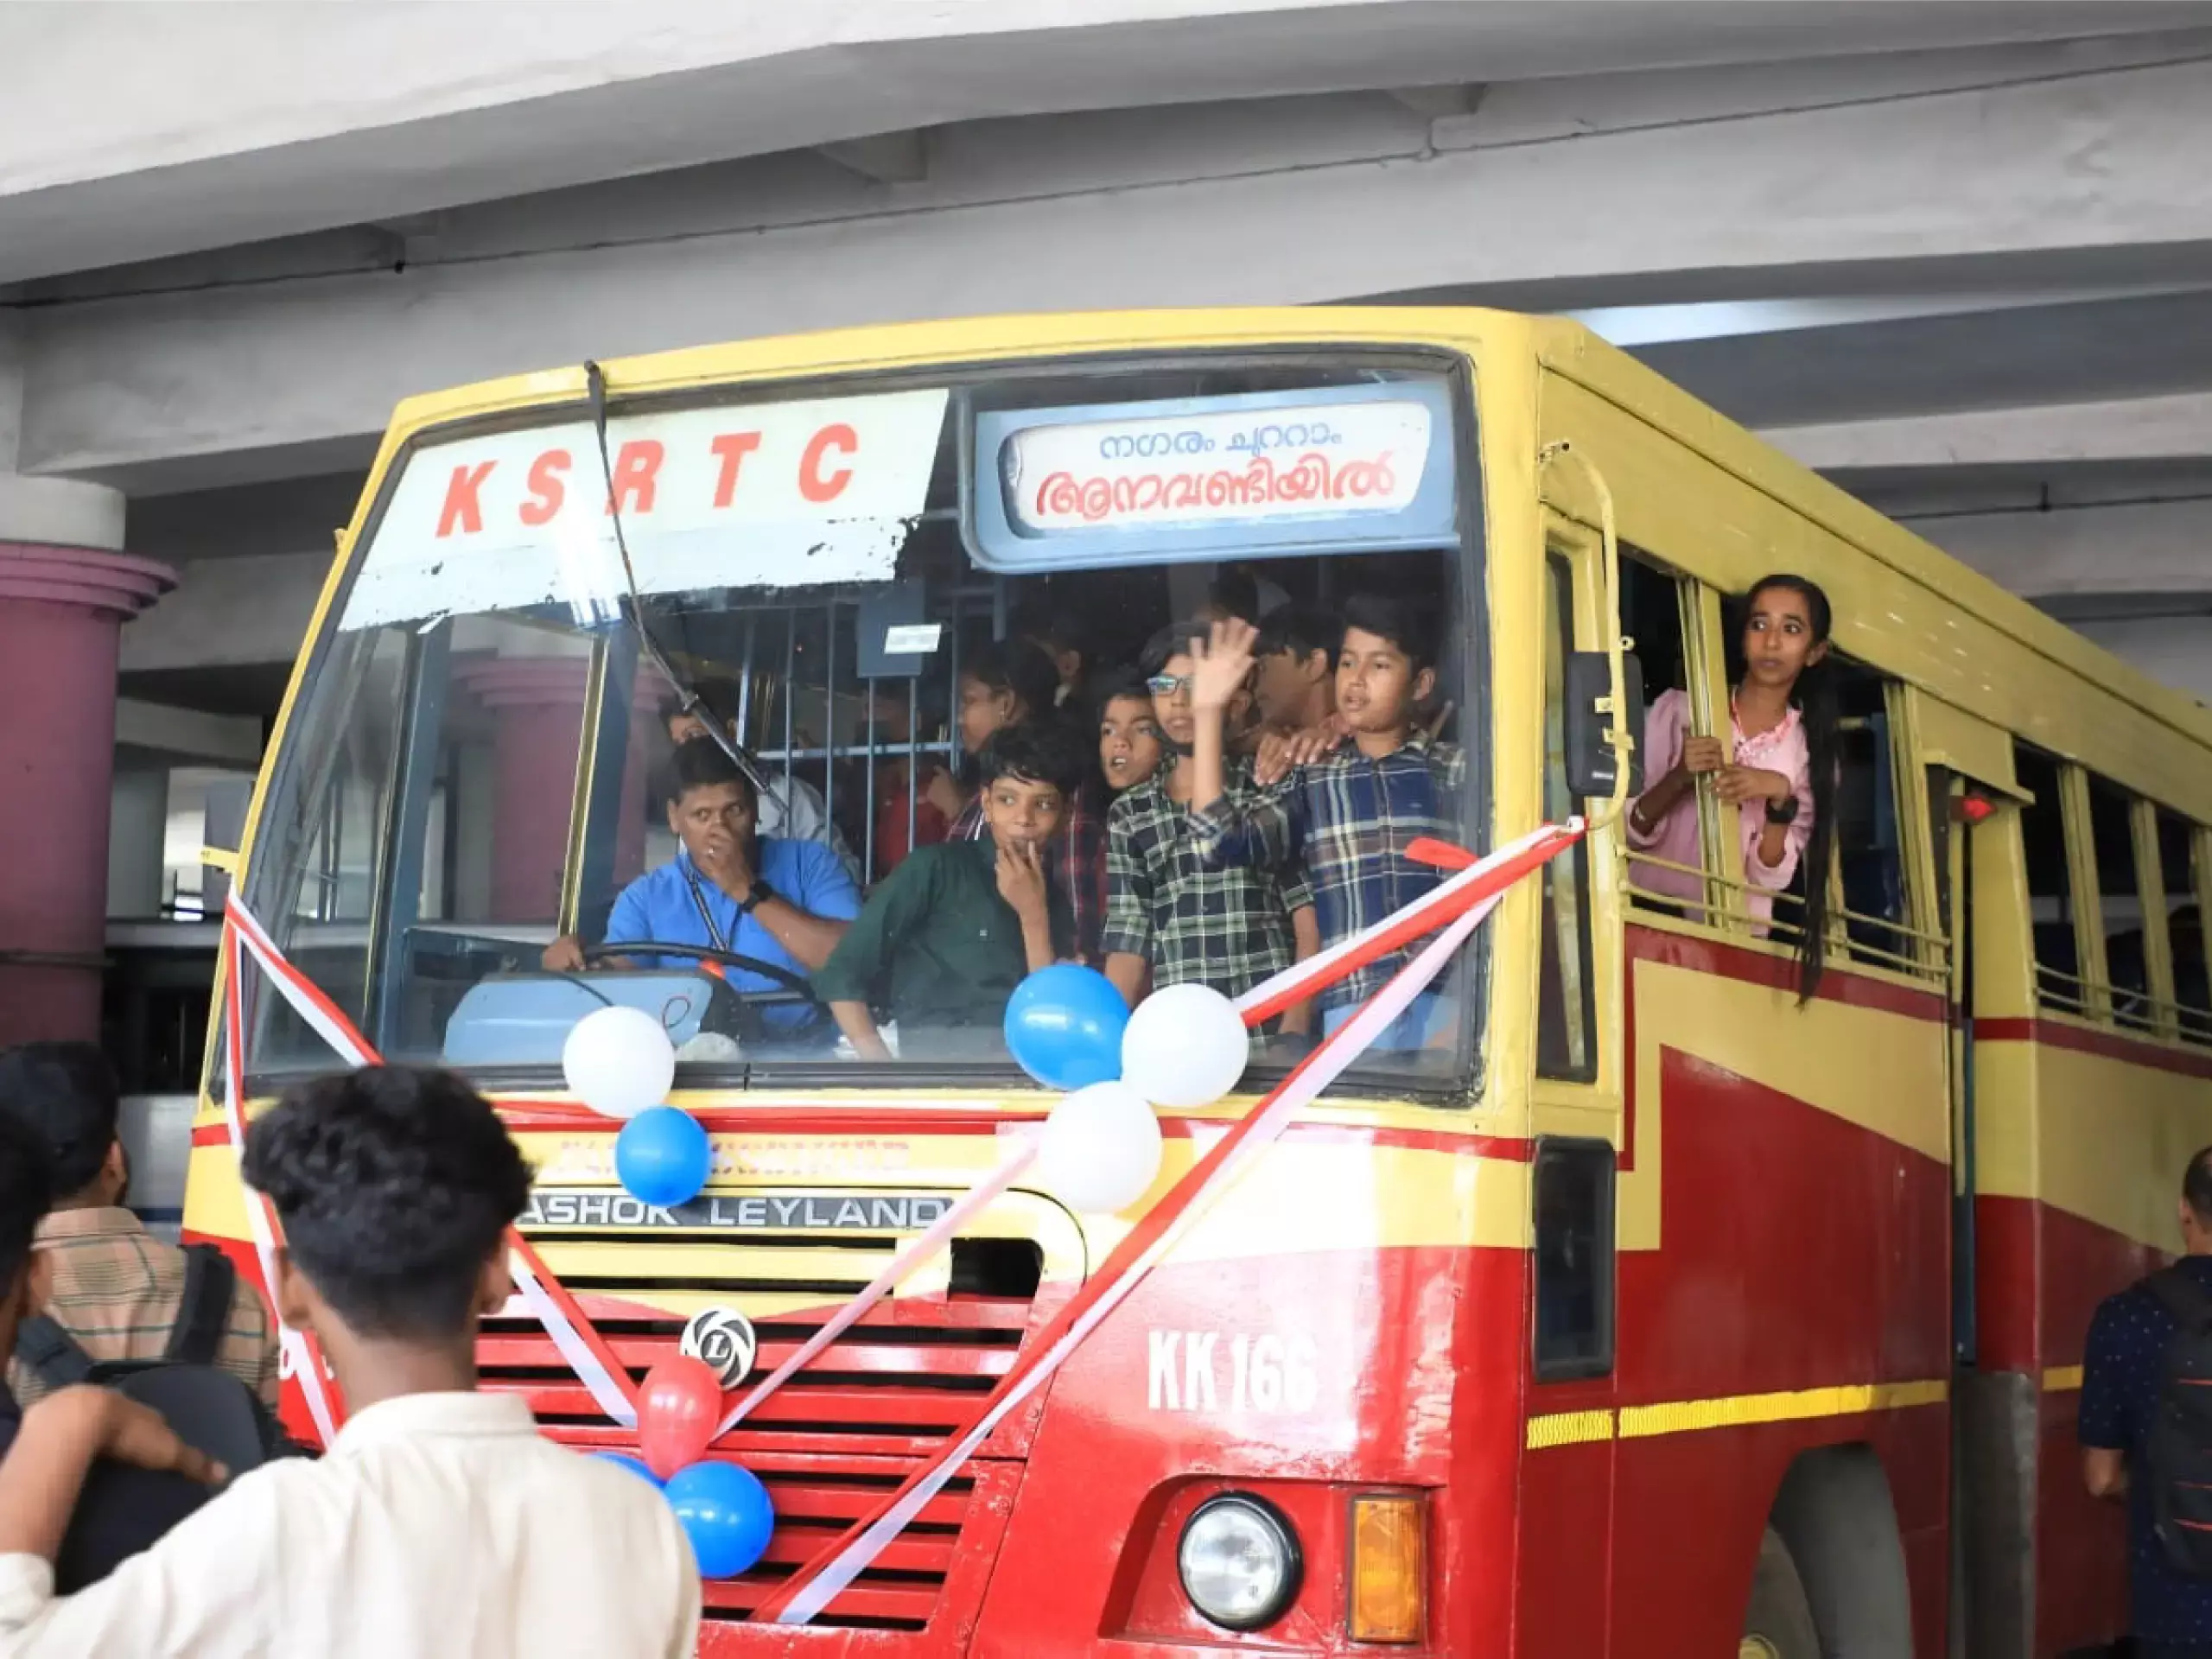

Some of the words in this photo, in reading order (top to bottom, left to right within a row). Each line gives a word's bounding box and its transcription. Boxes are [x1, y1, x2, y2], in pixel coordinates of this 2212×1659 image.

[1100, 430, 1216, 459] നഗരം
[521, 1195, 679, 1225] ASHOK
[709, 1198, 945, 1226] LEYLAND
